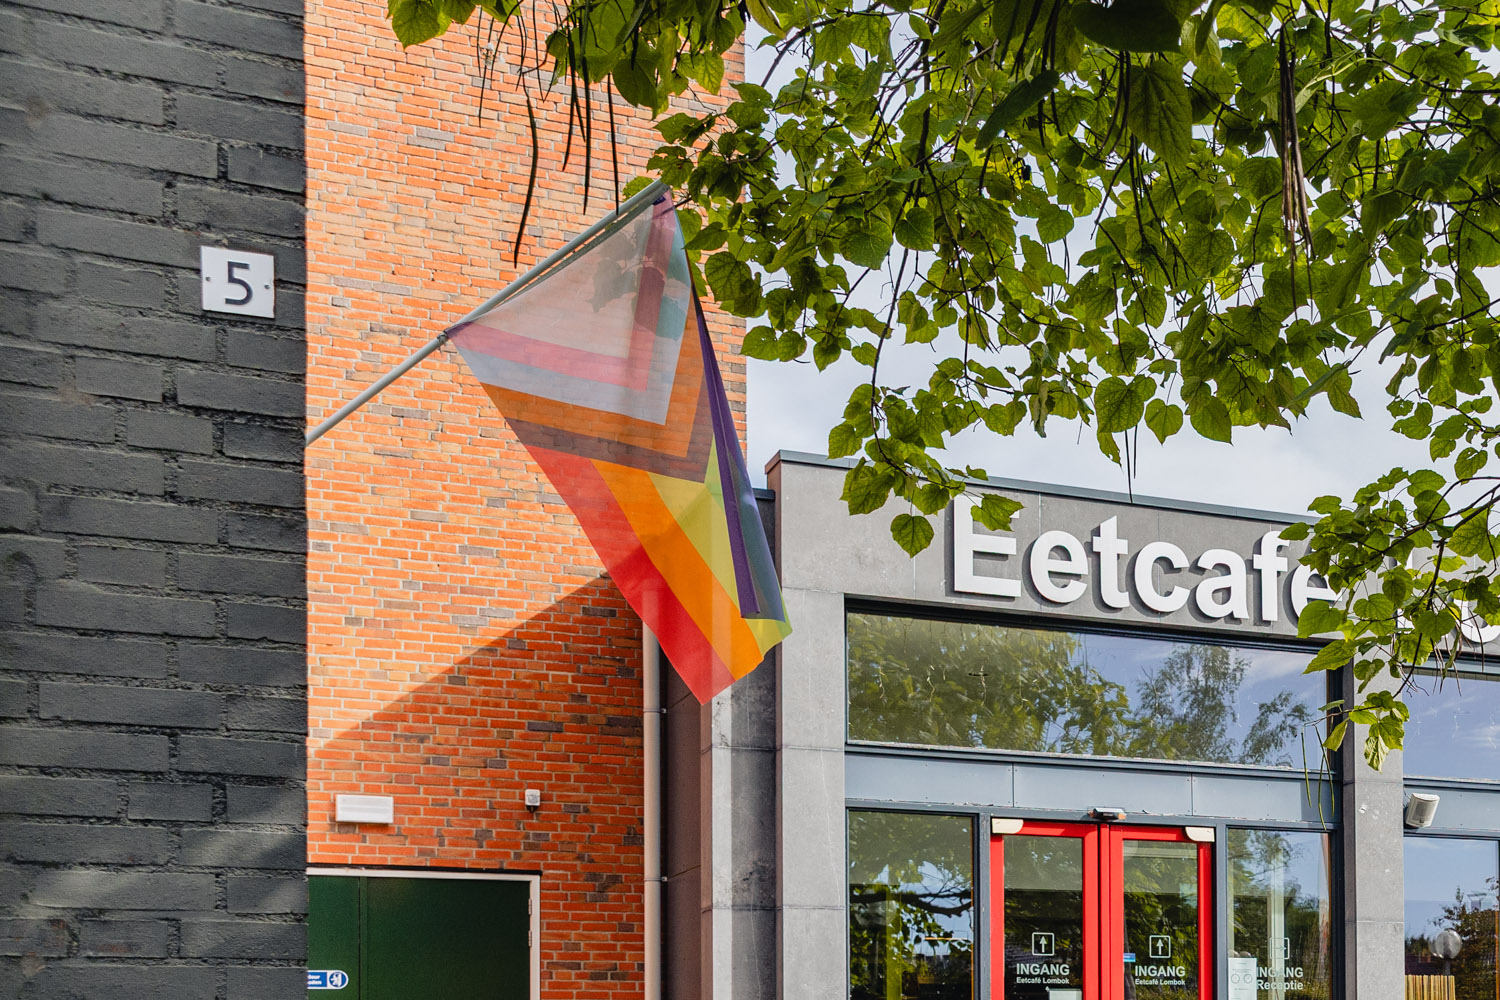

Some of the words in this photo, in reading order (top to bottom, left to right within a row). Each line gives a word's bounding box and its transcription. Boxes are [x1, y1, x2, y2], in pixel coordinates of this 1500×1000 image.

[225, 261, 253, 306] 5
[1016, 963, 1070, 975] INGANG
[1134, 965, 1186, 977] INGANG
[1016, 976, 1042, 984] Eetcafé
[1043, 977, 1070, 985] Lombok
[1134, 978, 1159, 986] Eetcafé
[1256, 980, 1304, 993] Receptie
